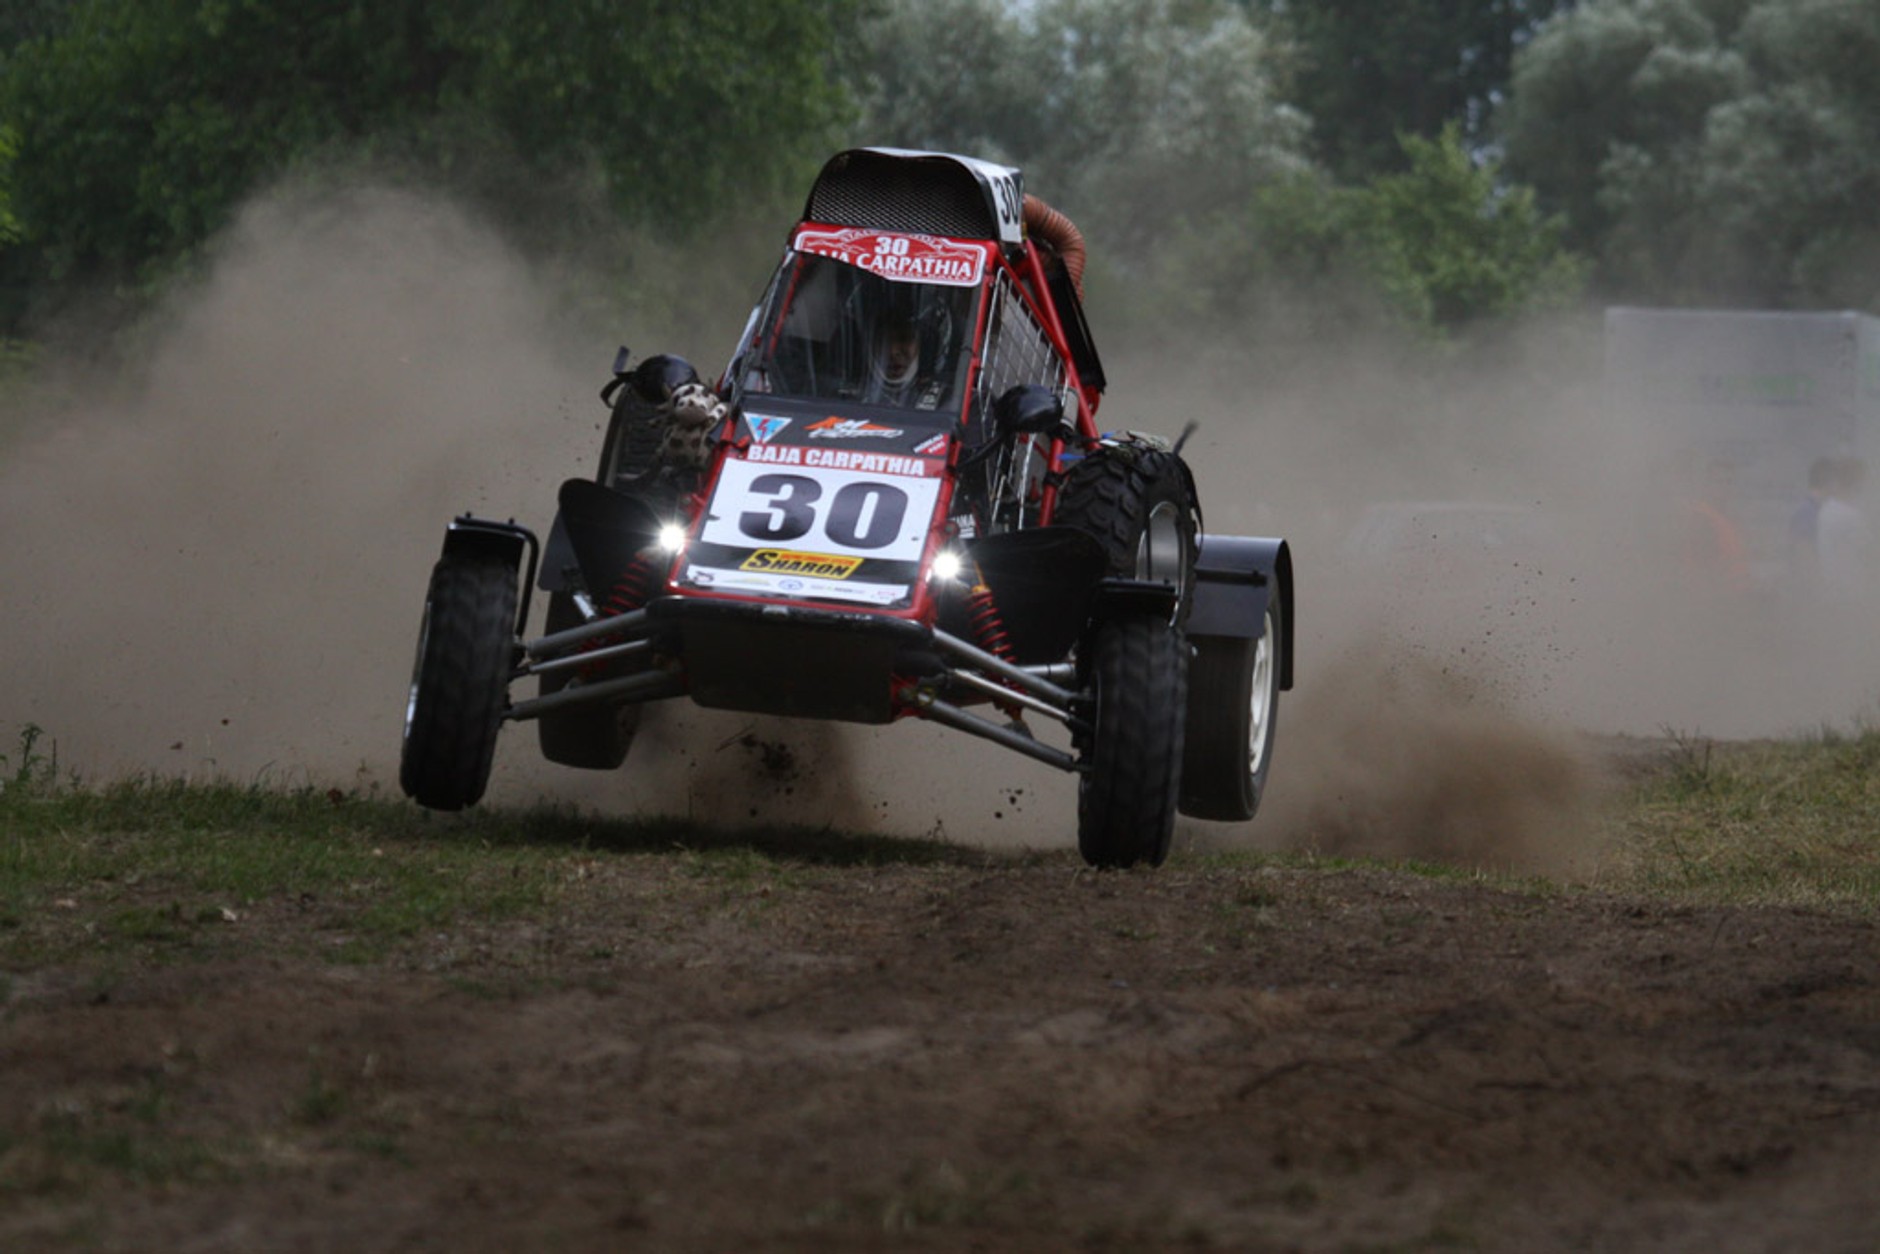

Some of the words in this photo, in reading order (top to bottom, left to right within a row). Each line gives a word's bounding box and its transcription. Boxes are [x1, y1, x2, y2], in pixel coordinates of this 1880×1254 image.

[874, 236, 909, 256] 30
[856, 253, 972, 278] CARPATHIA
[747, 444, 801, 465] BAJA
[805, 449, 925, 477] CARPATHIA
[738, 473, 909, 550] 30
